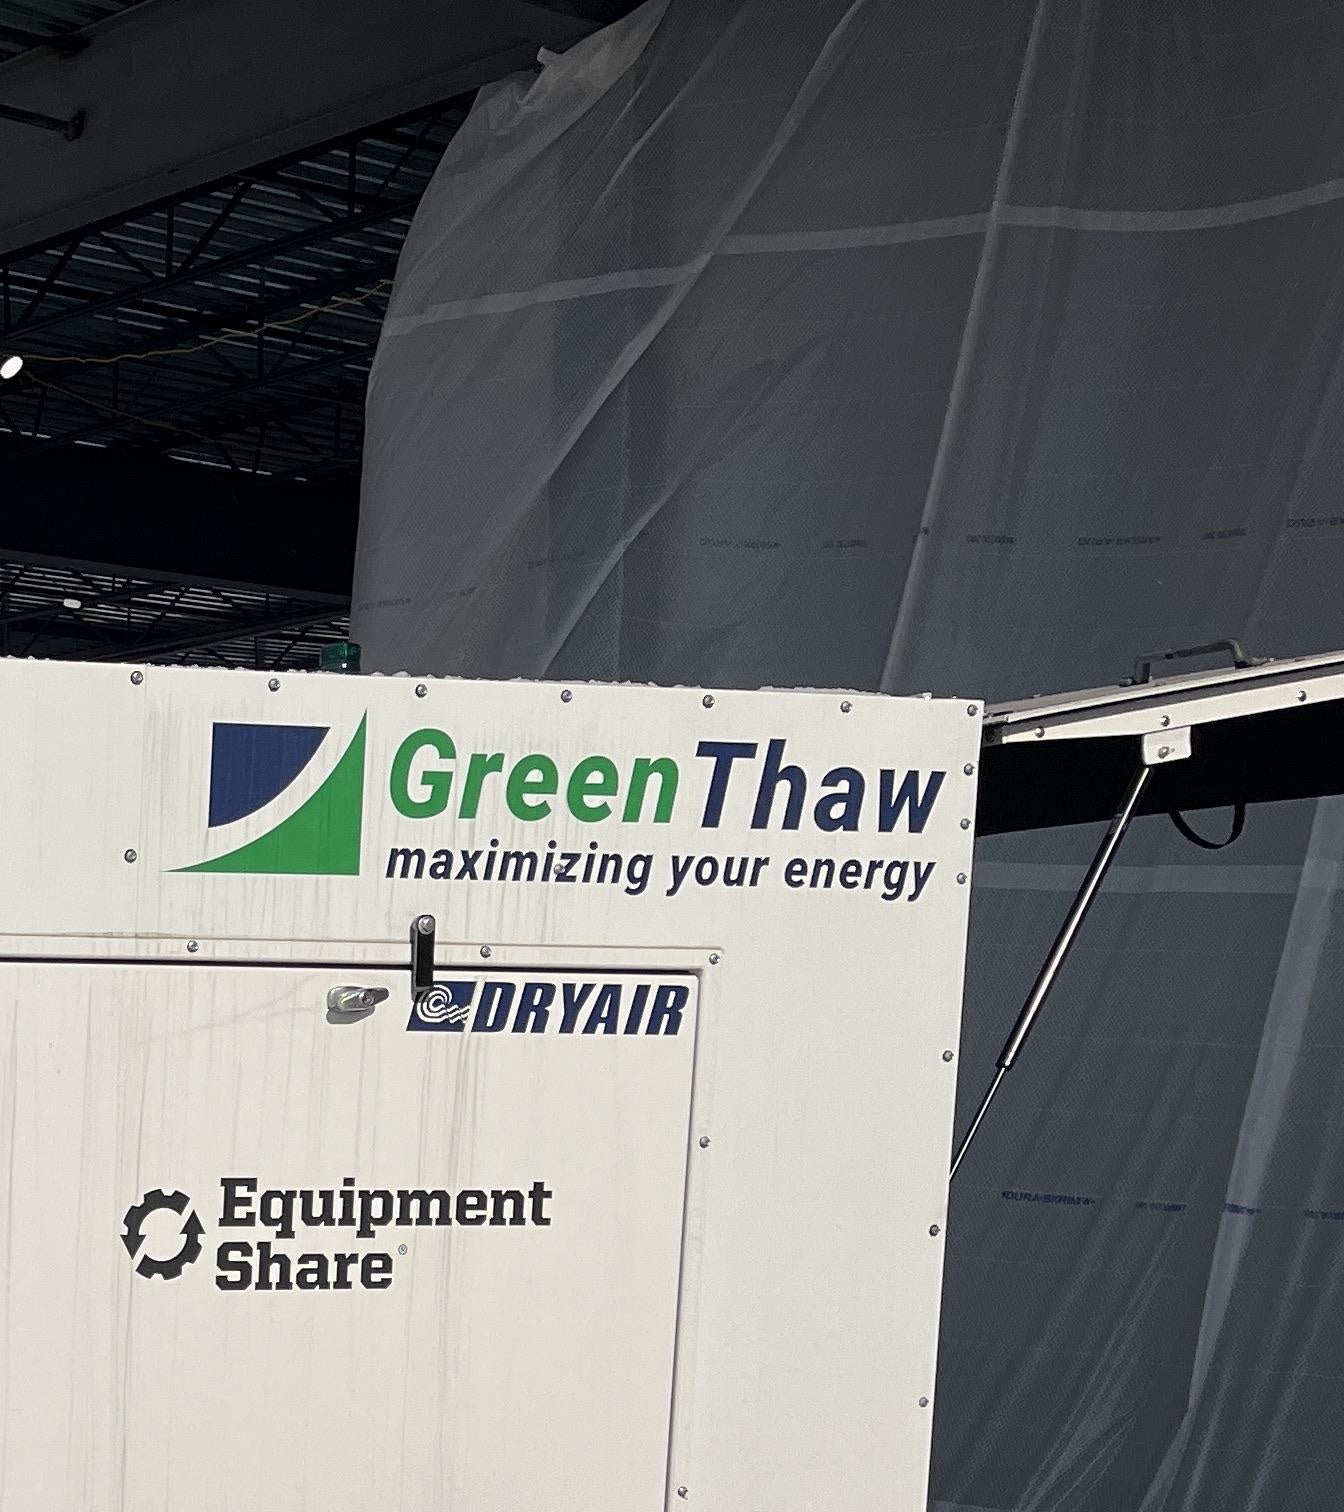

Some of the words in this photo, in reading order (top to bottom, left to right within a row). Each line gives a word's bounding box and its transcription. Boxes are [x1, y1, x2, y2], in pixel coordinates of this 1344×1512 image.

[385, 841, 652, 896] maximizing
[666, 855, 772, 898] your
[784, 858, 937, 902] energy
[470, 980, 691, 1036] DRYAIR
[217, 1177, 553, 1239] Equipment
[215, 1241, 394, 1291] Share
